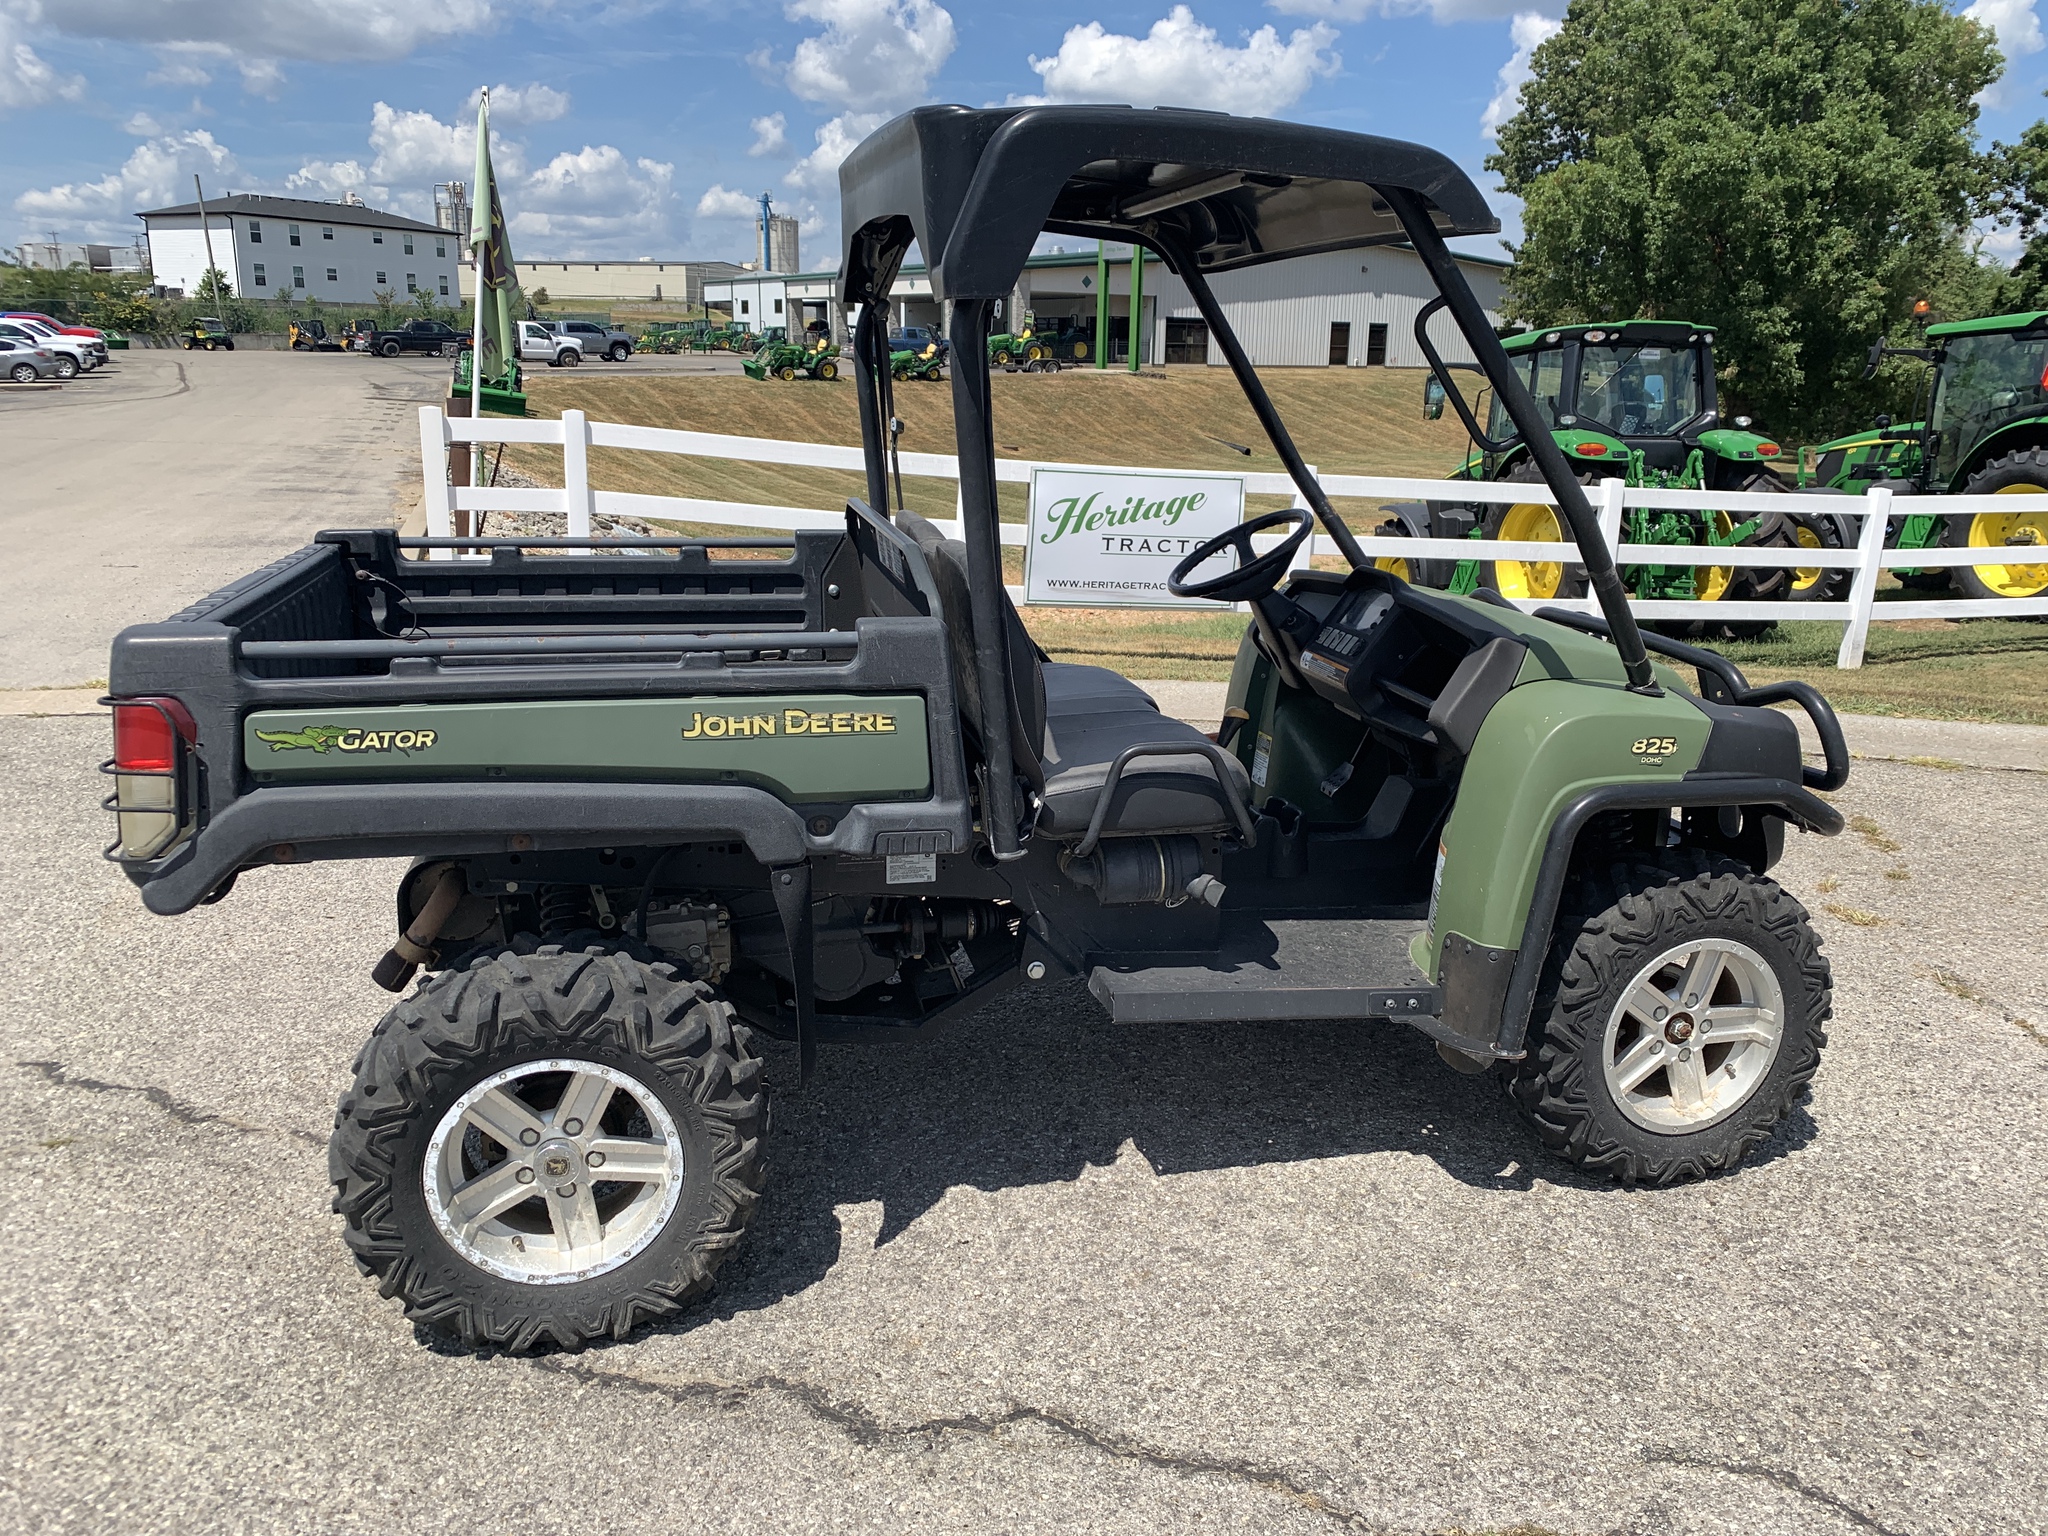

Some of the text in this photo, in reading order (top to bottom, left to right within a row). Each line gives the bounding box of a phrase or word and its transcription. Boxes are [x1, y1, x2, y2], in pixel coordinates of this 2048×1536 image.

[1040, 491, 1208, 544] Heritage
[1047, 579, 1188, 591] WWW.HERITAGETRAC
[682, 708, 897, 739] JOHN DEERE
[337, 729, 437, 751] GATOR
